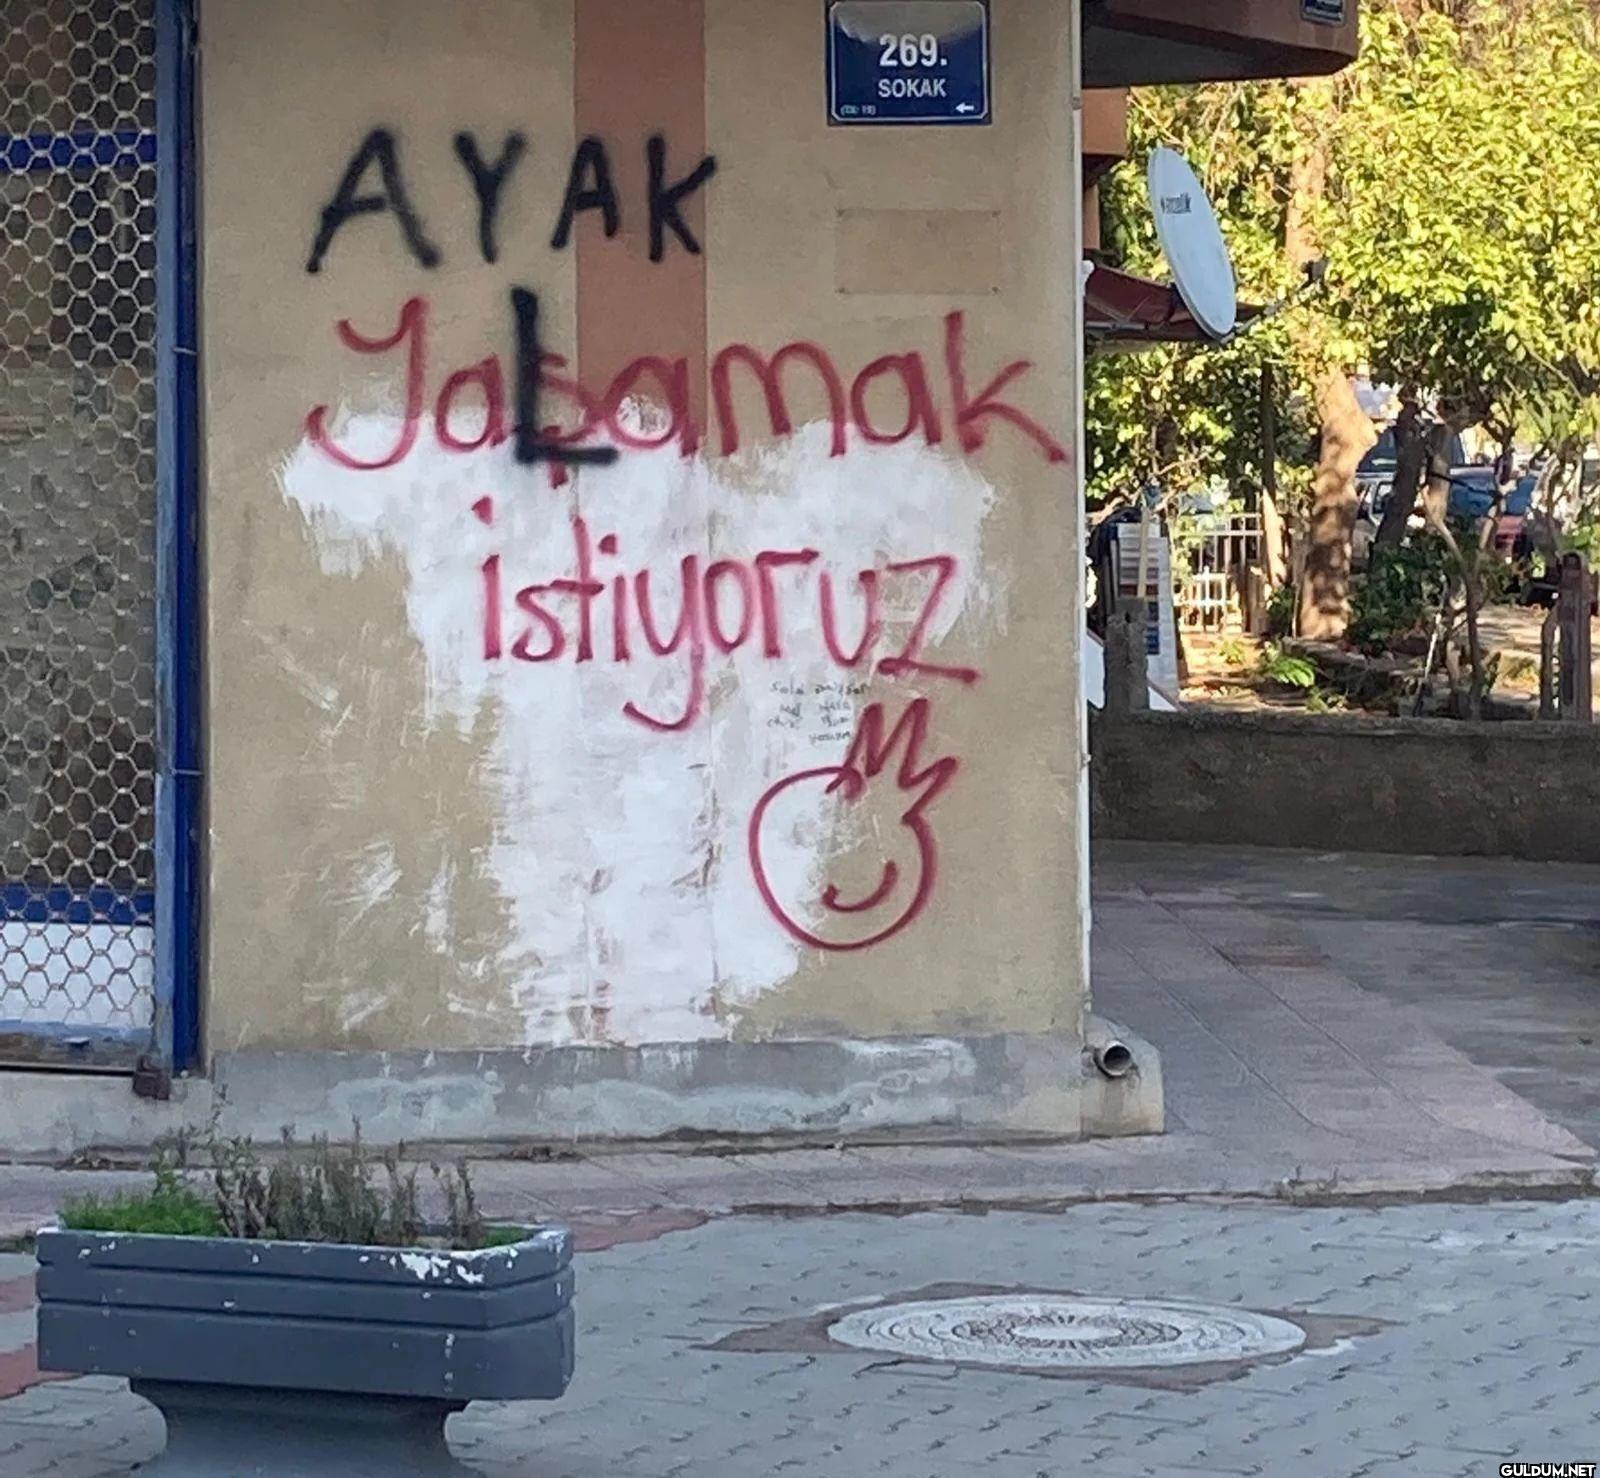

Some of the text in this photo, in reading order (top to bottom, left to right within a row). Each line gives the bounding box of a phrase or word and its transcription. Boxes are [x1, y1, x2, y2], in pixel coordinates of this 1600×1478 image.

[877, 78, 947, 98] SOKAK
[878, 33, 948, 67] 269.
[307, 127, 718, 273] AYAK
[471, 496, 980, 732] istiyoruz
